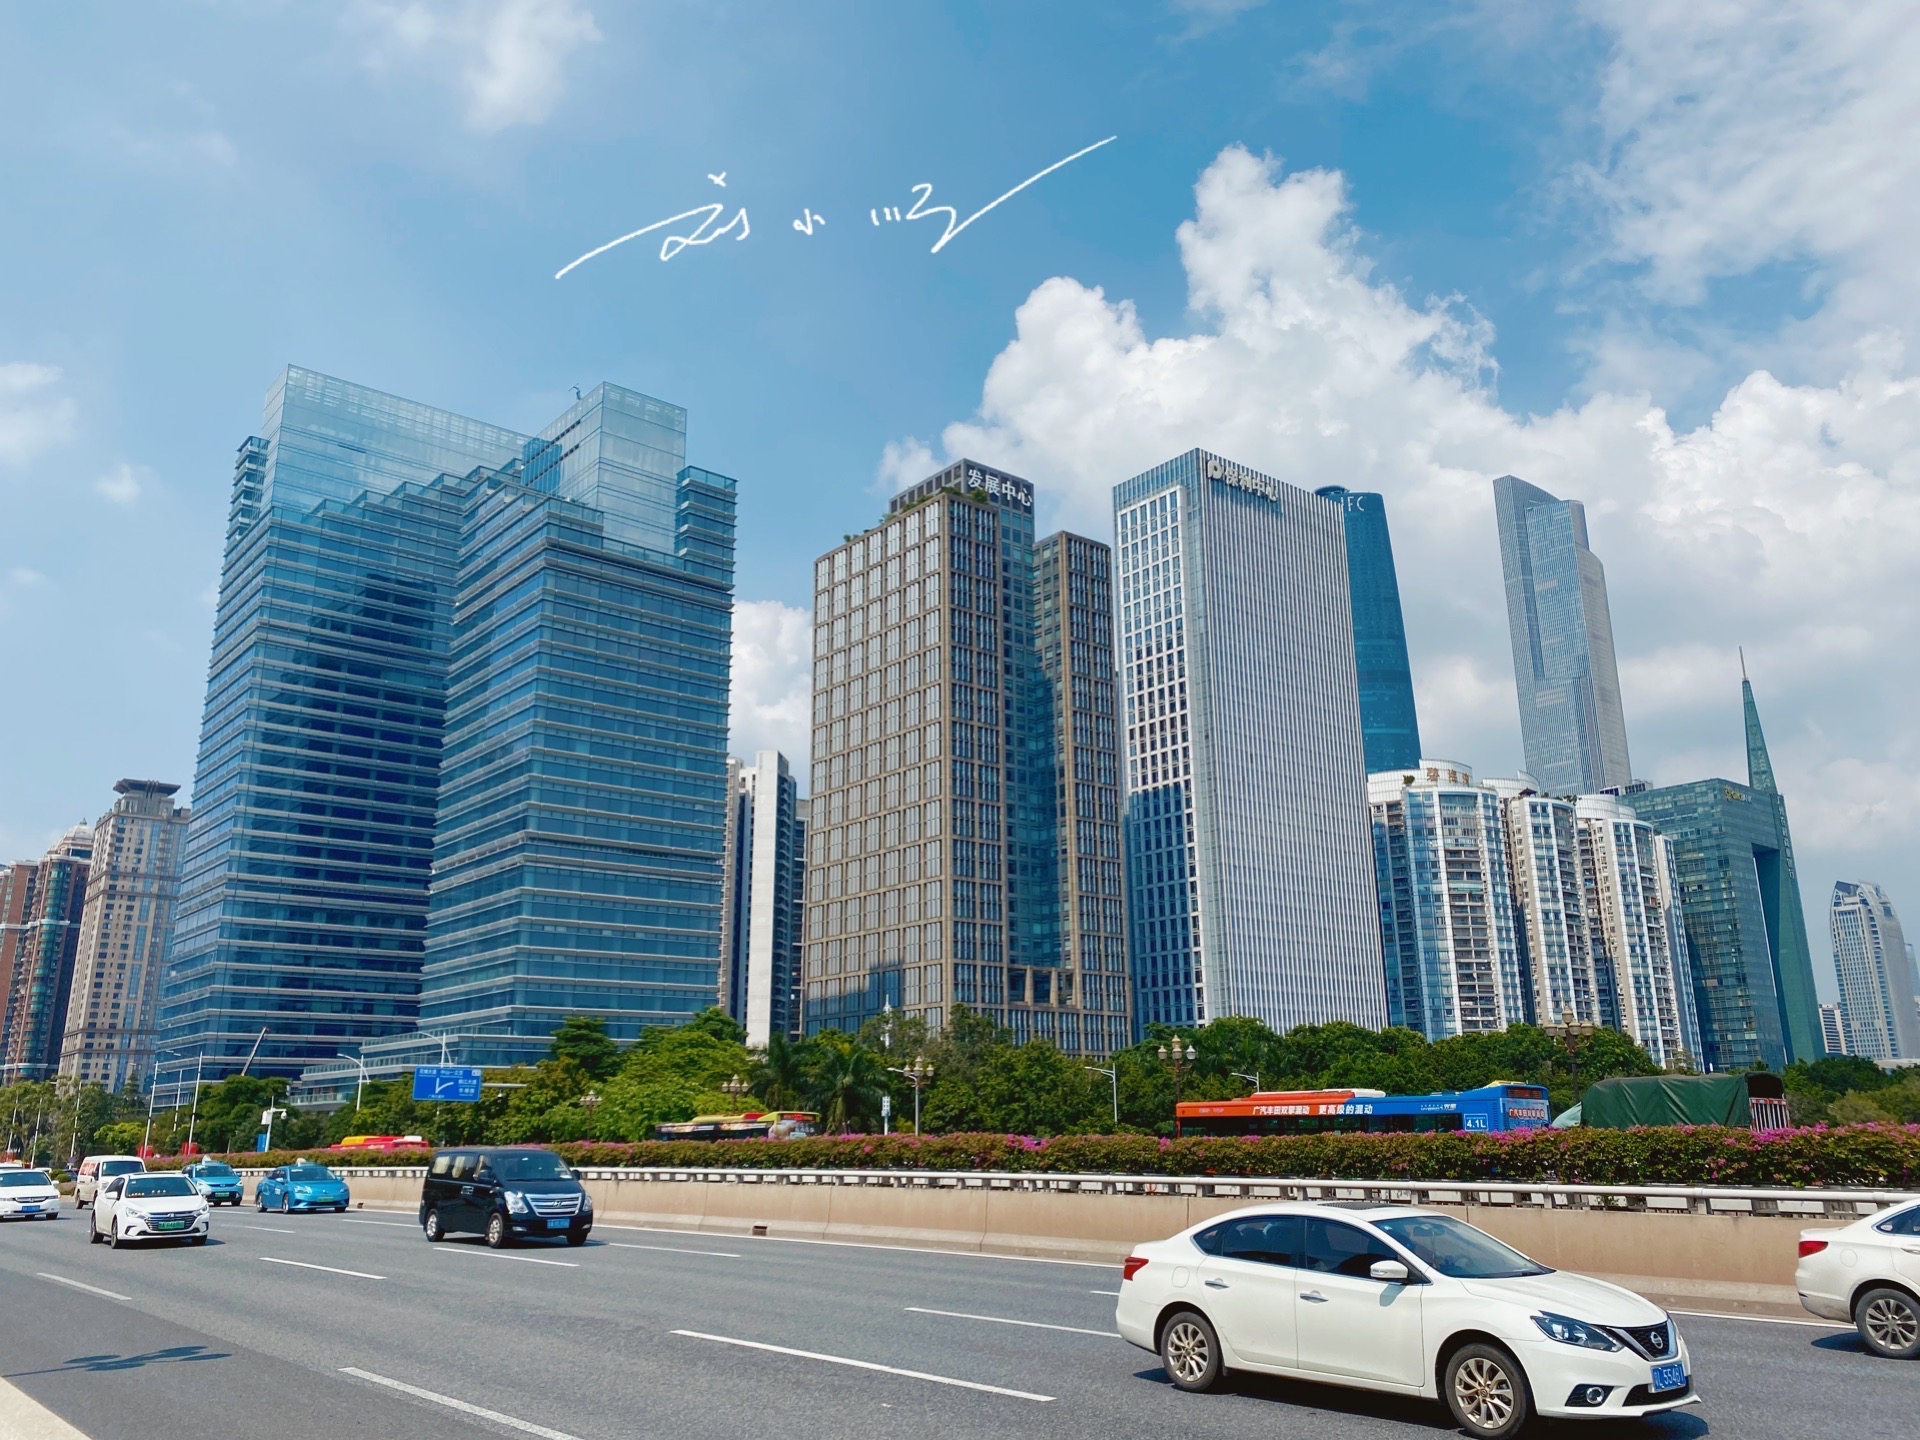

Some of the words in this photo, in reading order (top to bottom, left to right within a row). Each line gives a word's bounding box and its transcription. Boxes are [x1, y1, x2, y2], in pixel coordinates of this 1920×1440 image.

[967, 468, 1033, 507] 发展中心
[1224, 466, 1279, 502] 保利中心
[1318, 1104, 1373, 1115] 更高级的混动
[1466, 1119, 1486, 1128] 4.1L
